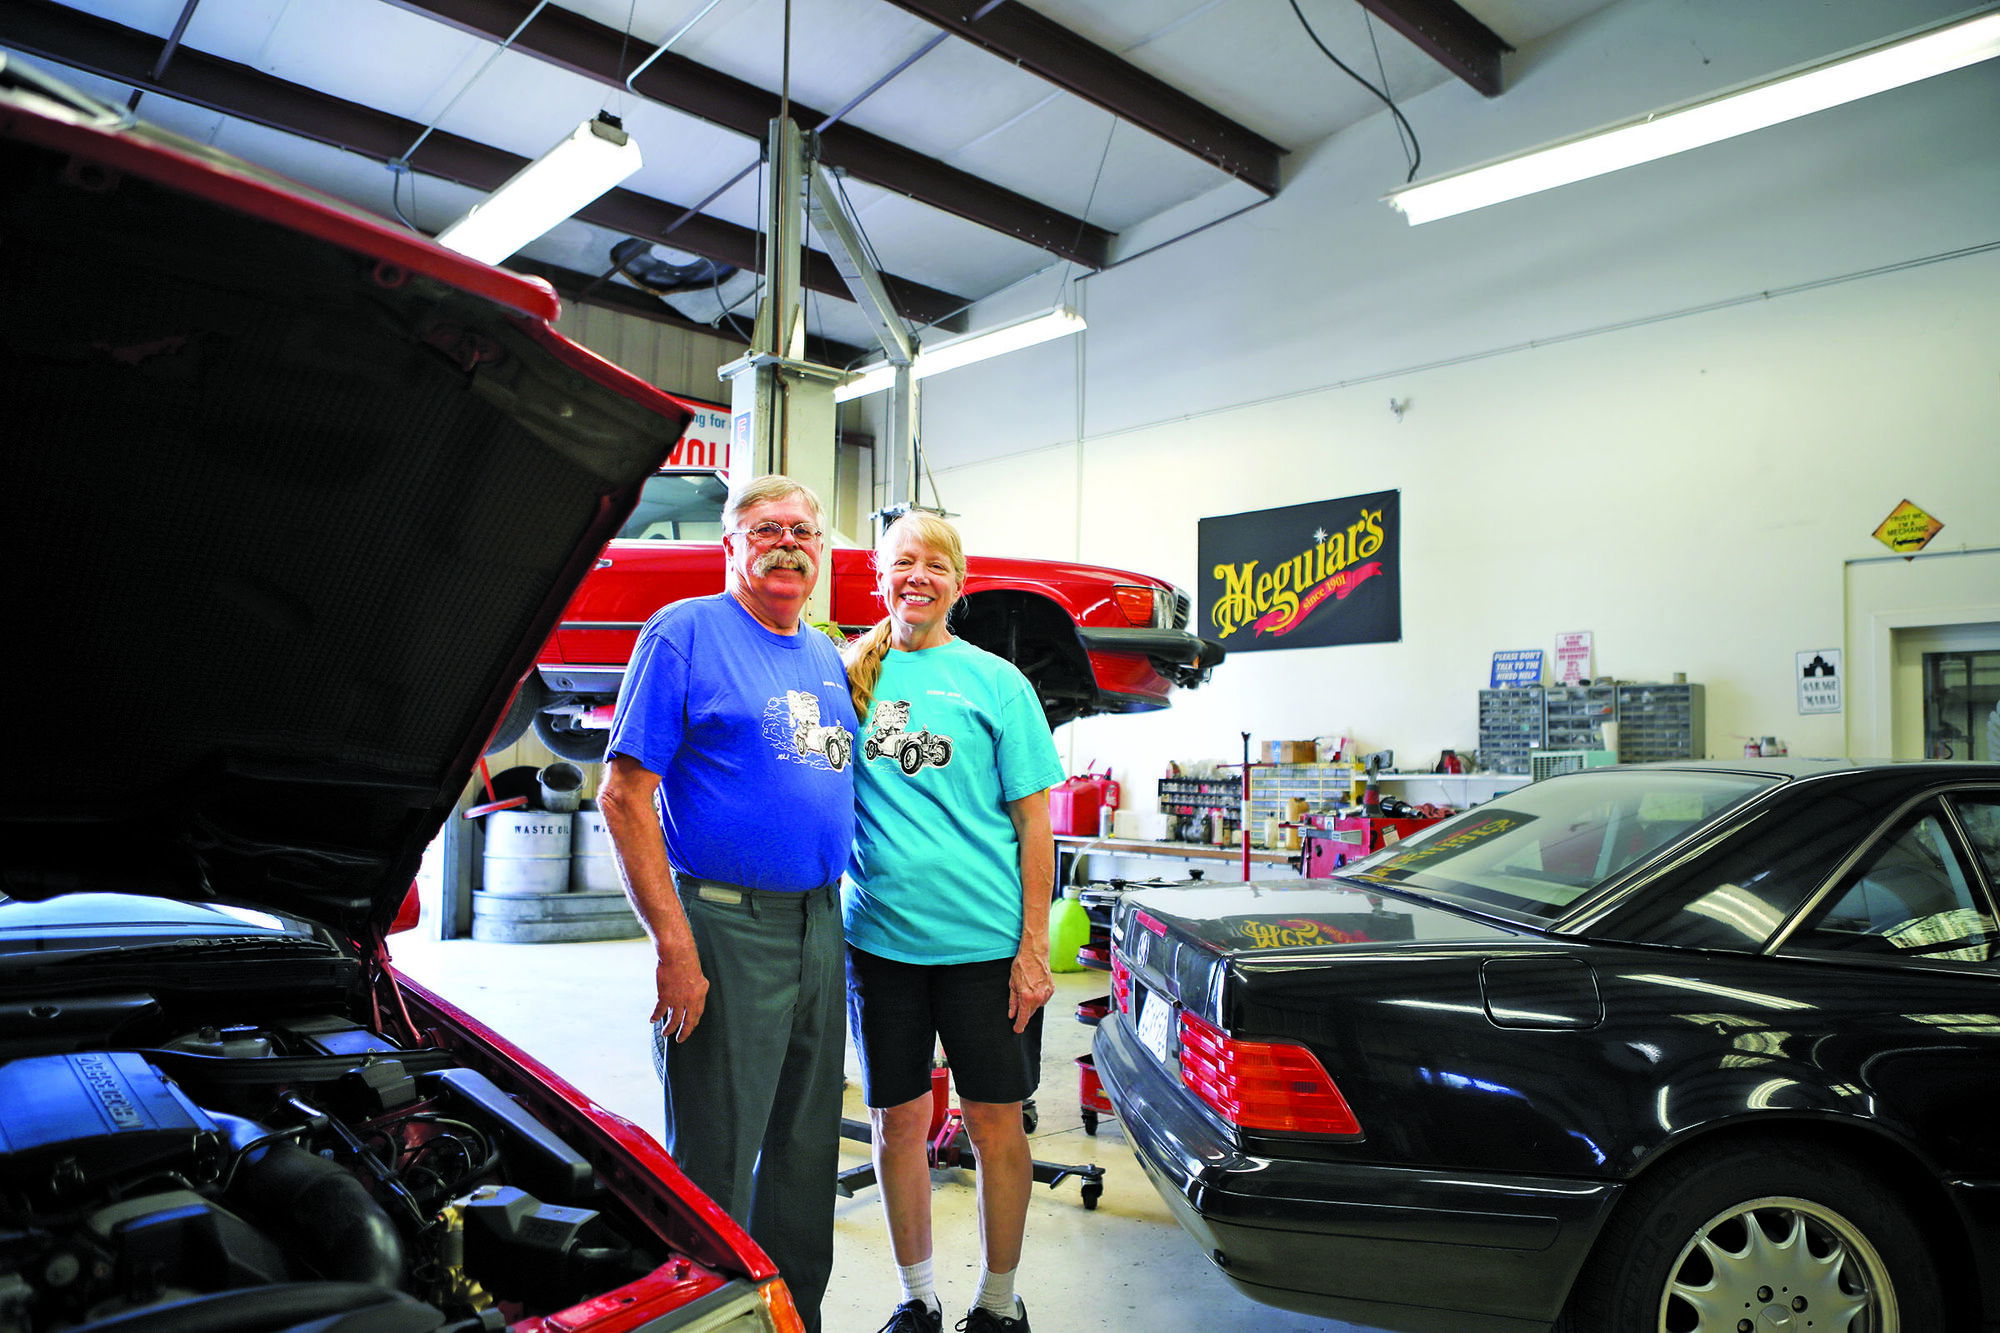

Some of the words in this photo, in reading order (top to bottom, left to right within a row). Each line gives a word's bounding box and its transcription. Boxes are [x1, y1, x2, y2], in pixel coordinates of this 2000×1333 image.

[710, 413, 726, 429] for
[1887, 525, 1929, 536] MECHANIC
[1211, 508, 1385, 639] Meguiar's
[1302, 590, 1326, 611] since
[1325, 574, 1347, 592] 1901
[1494, 652, 1519, 662] PLEASE
[1519, 651, 1542, 660] DON'T
[1497, 662, 1515, 671] TALK
[1514, 661, 1525, 670] TO
[1525, 660, 1540, 670] THE
[1496, 672, 1518, 681] HIRED
[1518, 671, 1537, 680] HELP
[1803, 680, 1837, 692] GARAGE
[514, 825, 554, 835] WASTE
[557, 825, 570, 835] OIL
